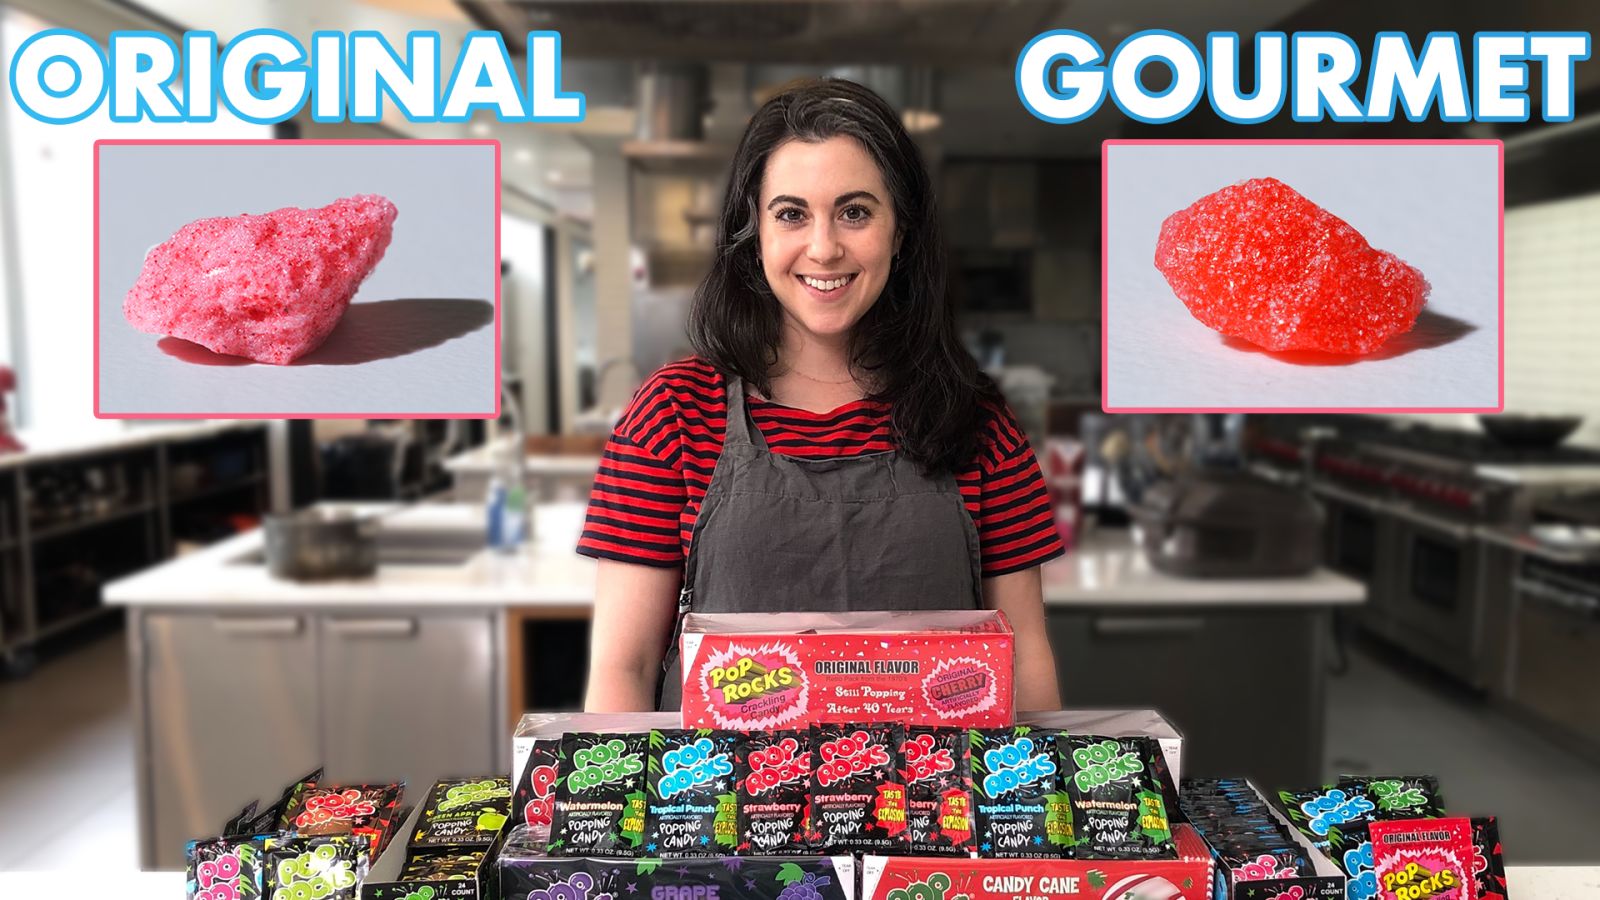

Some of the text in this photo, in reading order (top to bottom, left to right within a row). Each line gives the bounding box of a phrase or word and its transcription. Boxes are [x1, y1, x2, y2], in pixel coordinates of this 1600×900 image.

[710, 657, 753, 689] POP
[815, 660, 920, 675] ORIGINAL FLAVOR
[936, 666, 977, 683] ORIGINAL
[722, 667, 793, 704] ROCKS
[835, 686, 906, 701] Still Popping
[931, 672, 987, 701] CHERRY
[740, 694, 787, 713] Crackling
[826, 703, 914, 714] After 40 Years
[750, 705, 782, 719] Candy
[573, 738, 626, 771] POP
[748, 737, 799, 772] POP
[820, 730, 870, 764] POP
[905, 734, 936, 763] OP
[1073, 740, 1121, 770] POP
[662, 737, 714, 774] POP
[984, 737, 1034, 774] POP
[566, 753, 643, 795] ROCKS
[816, 745, 890, 788] ROCKS
[907, 748, 956, 786] CKS
[1074, 751, 1144, 792] ROCKS
[658, 753, 733, 800] ROCKS
[983, 752, 1057, 799] ROCKS
[1373, 780, 1405, 797] OP
[306, 789, 361, 812] POP
[560, 801, 624, 811] Watermelon
[814, 793, 872, 804] Strawberry
[909, 800, 938, 810] berry
[1075, 800, 1137, 810] Watermelon
[1301, 789, 1346, 818] POP
[1385, 788, 1428, 811] CKS
[296, 799, 376, 828] ROCKS
[454, 810, 482, 818] APPLE
[649, 804, 715, 815] Tropical Punch
[743, 803, 802, 813] Strawberry
[822, 808, 865, 823] POPPING
[978, 803, 1045, 815] Tropical Punch
[432, 819, 473, 830] POPPING
[434, 826, 467, 837] CANDY
[568, 816, 611, 832] POPPING
[659, 820, 702, 836] POPPING
[751, 818, 794, 834] POPPING
[828, 821, 862, 835] CANDY
[990, 820, 1033, 835] POPPING
[1088, 816, 1129, 831] POPPING
[571, 830, 606, 844] CANDY
[663, 833, 698, 848] CANDY
[755, 831, 791, 847] CANDY
[997, 833, 1031, 848] CANDY
[1095, 829, 1128, 843] CANDY
[1383, 831, 1451, 844] ORIGINAL FLAVOR
[197, 845, 241, 889] PO
[278, 844, 337, 887] POP
[982, 876, 1080, 894] CANDY CANE
[1383, 862, 1418, 892] POP
[1395, 869, 1455, 900] ROCKS
[651, 885, 721, 900] GRAPE
